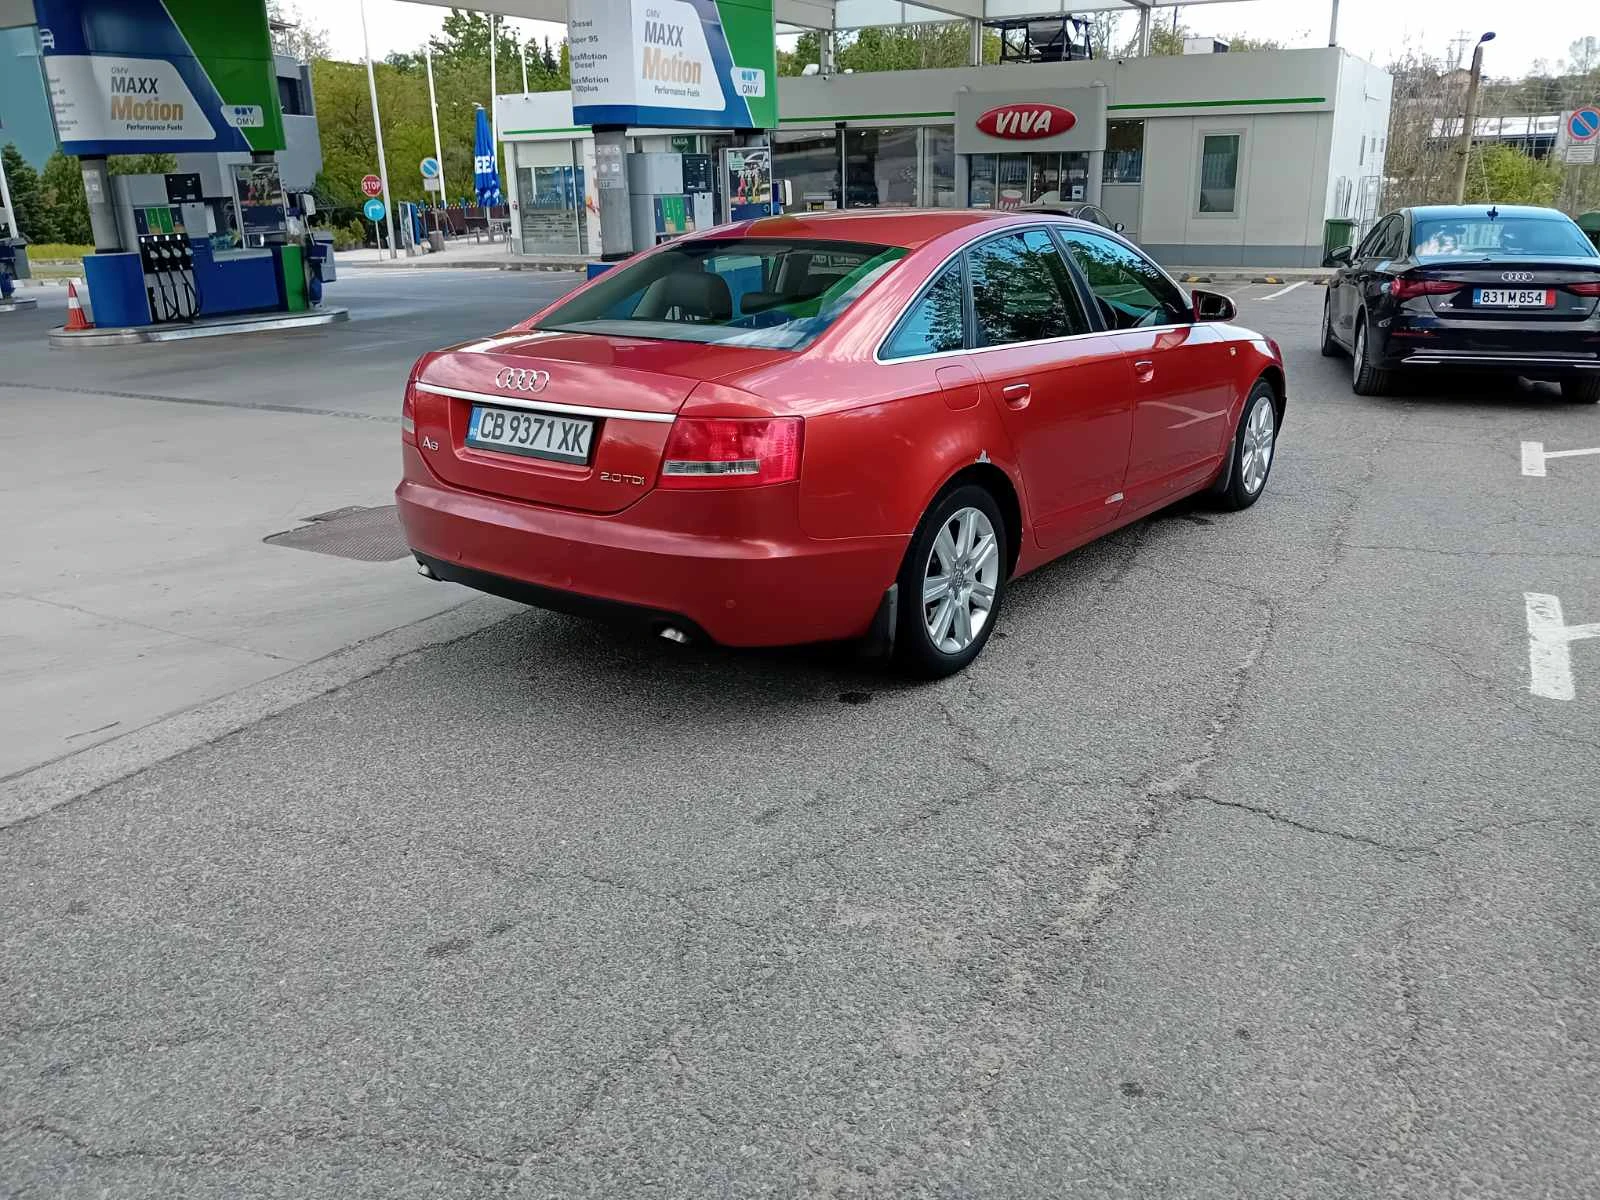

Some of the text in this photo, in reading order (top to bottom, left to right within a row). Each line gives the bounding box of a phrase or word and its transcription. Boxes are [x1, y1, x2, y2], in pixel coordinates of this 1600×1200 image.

[644, 21, 684, 47] MAXX
[642, 46, 702, 85] Motion
[111, 76, 159, 94] MAXX
[742, 85, 758, 95] OMV
[111, 95, 184, 121] Motion
[126, 123, 183, 132] Performance Fuels
[236, 117, 255, 126] OMV
[996, 110, 1052, 134] VIVA
[363, 180, 381, 191] STOP
[1482, 292, 1505, 304] 831
[1508, 292, 1518, 303] M
[1519, 292, 1543, 304] 854
[480, 411, 589, 454] CB 9371 XK
